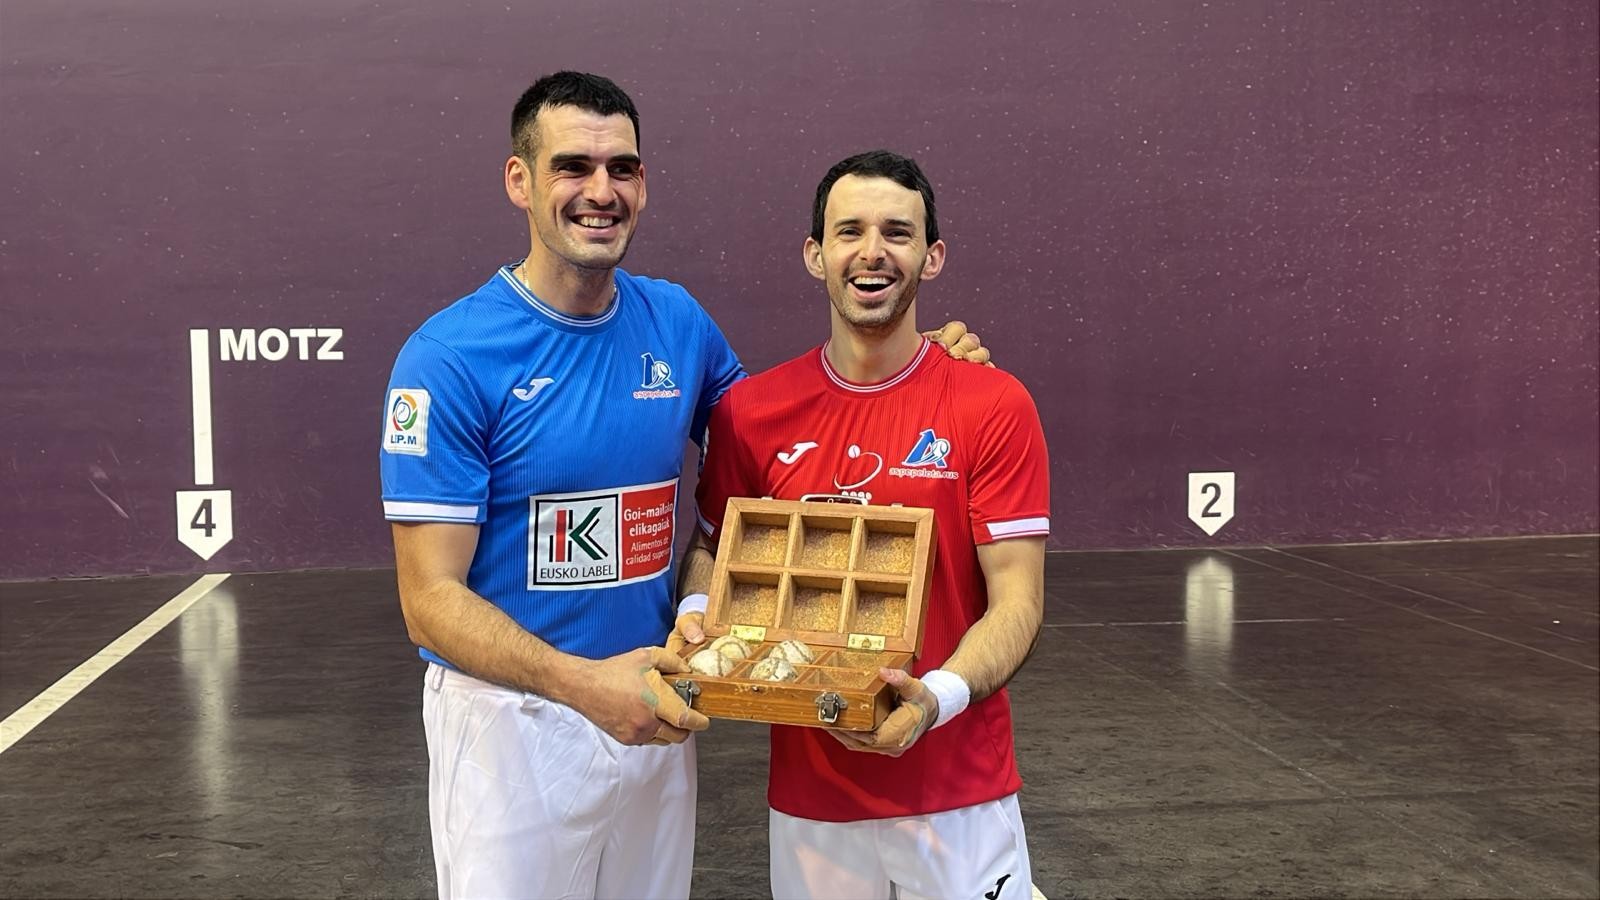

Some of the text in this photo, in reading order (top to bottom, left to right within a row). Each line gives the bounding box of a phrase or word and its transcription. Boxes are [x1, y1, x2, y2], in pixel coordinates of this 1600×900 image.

[219, 328, 344, 361] MOTZ
[1201, 482, 1222, 518] 2
[190, 498, 216, 537] 4
[540, 564, 614, 579] EUSKO LABEL
[625, 552, 651, 566] calidad
